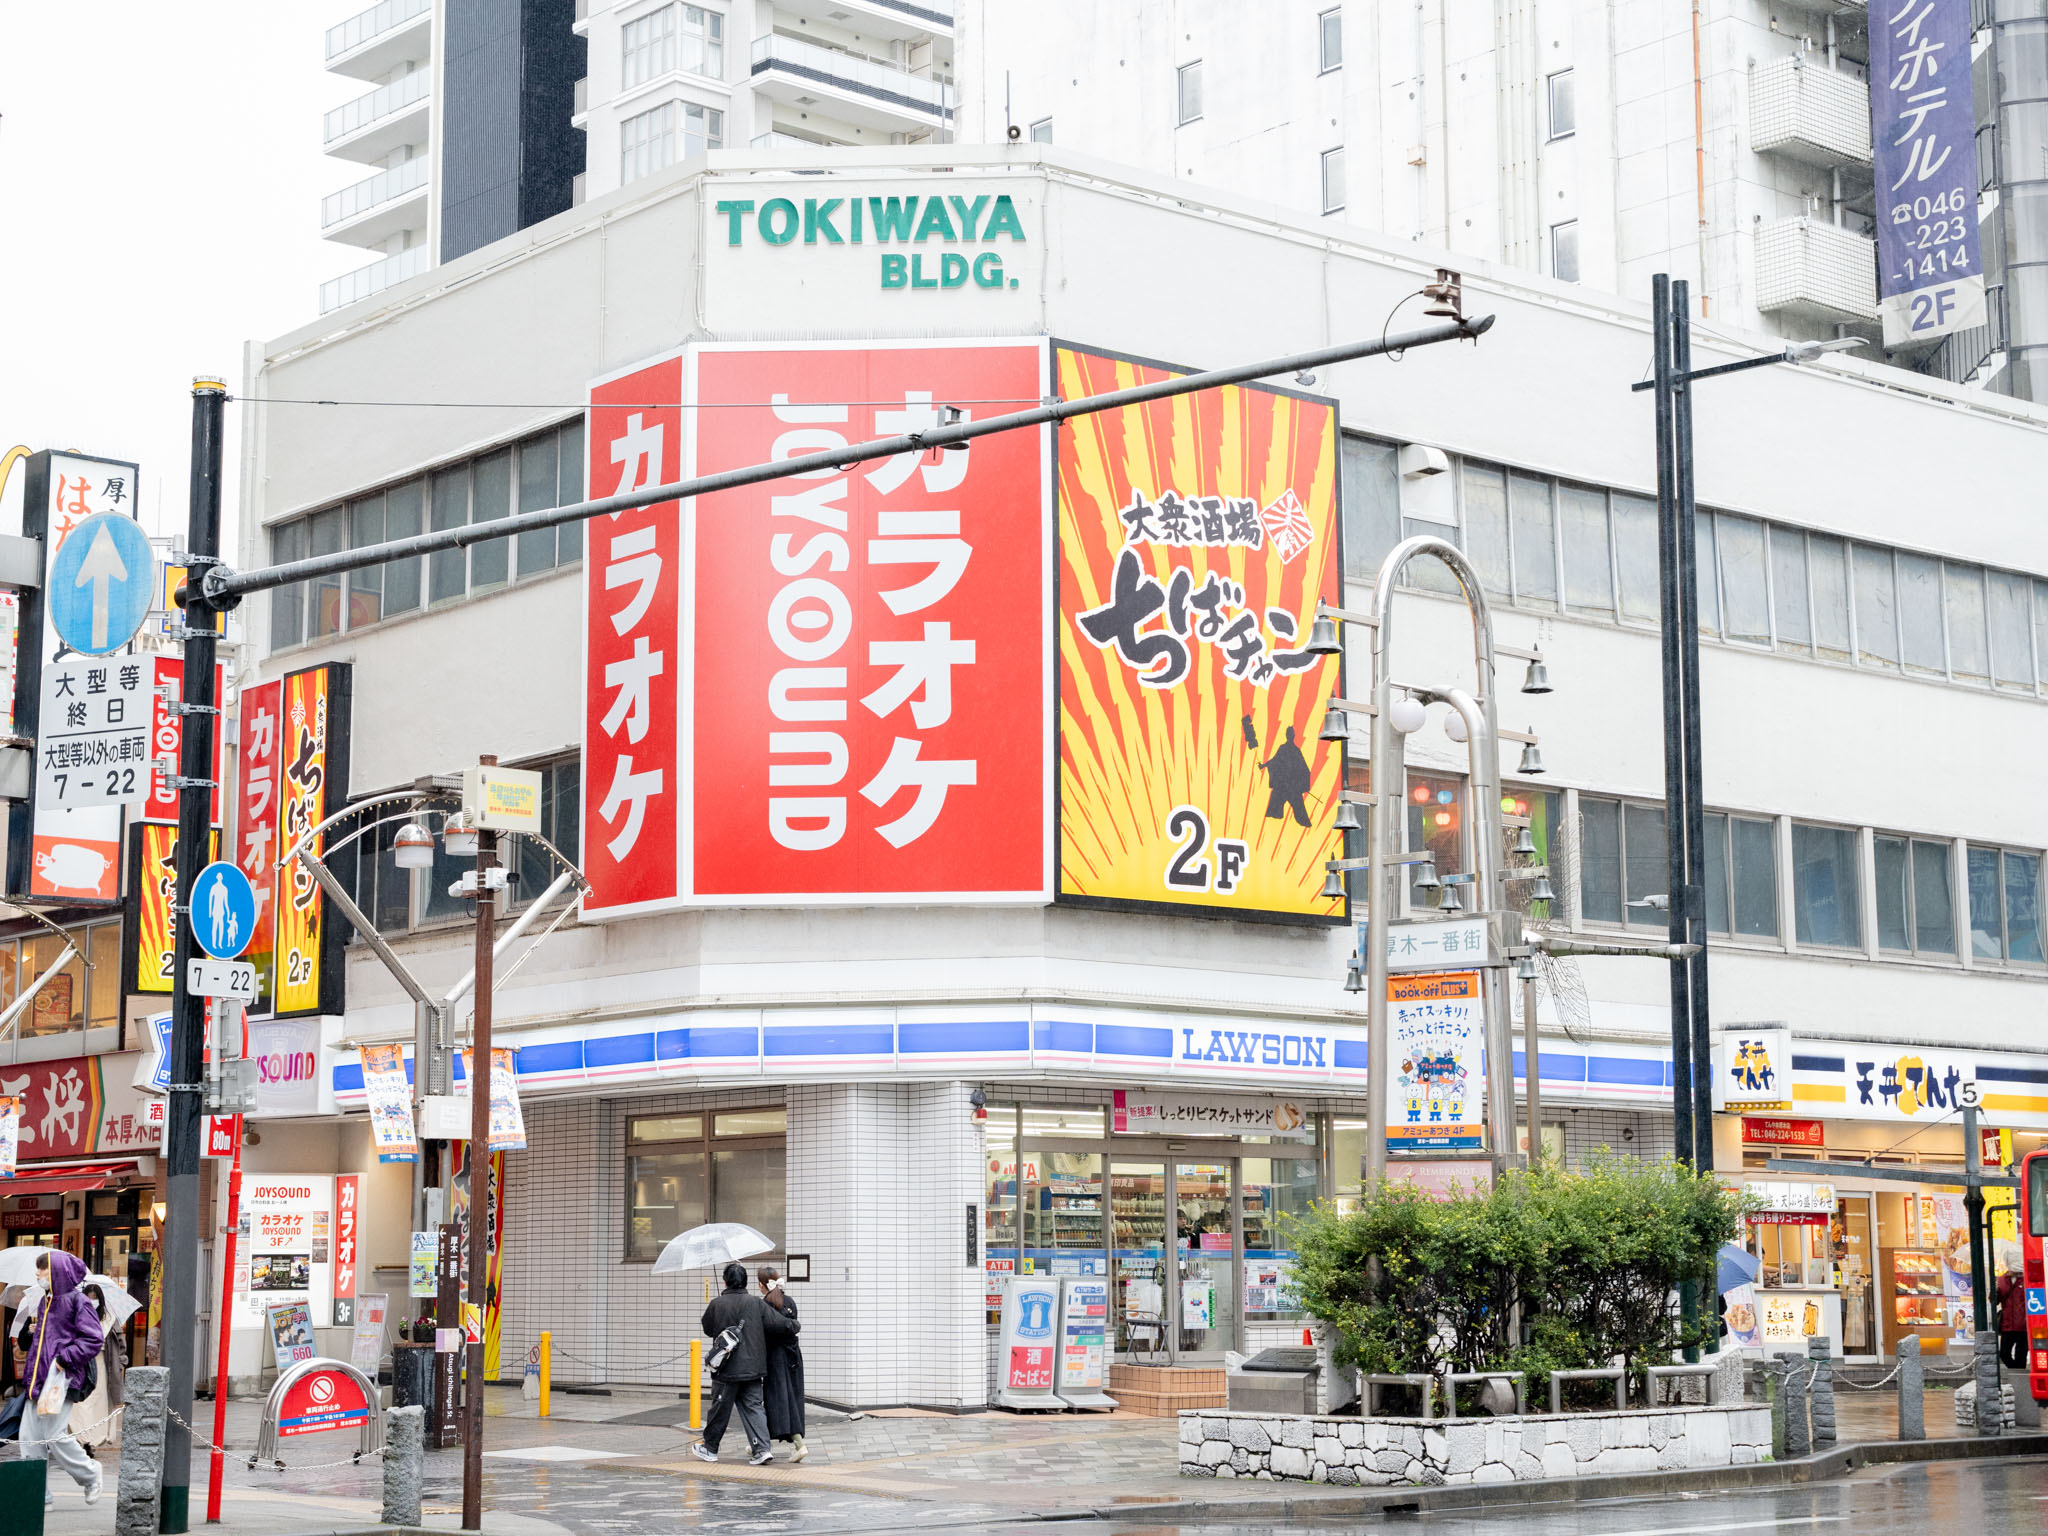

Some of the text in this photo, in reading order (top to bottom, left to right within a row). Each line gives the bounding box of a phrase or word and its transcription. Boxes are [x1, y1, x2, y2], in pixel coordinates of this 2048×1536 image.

[716, 195, 1026, 246] TOKIWAYA
[881, 252, 1019, 289] BLDG.
[1911, 288, 1956, 332] 2F
[1121, 489, 1262, 547] 大衆酒場
[767, 393, 852, 851] JOYSOUND
[858, 391, 977, 849] カラオケ
[1079, 549, 1321, 685] ちばチャン
[599, 412, 664, 863] カラオケ
[55, 664, 140, 698] 大型等
[67, 698, 125, 728] 終日
[44, 735, 146, 770] 大型等以外の車両
[243, 706, 275, 928] カラオケ
[1168, 810, 1246, 890] 2F
[289, 951, 311, 982] 2F
[1182, 1029, 1326, 1067] LAWSON
[1731, 1065, 1774, 1090] てんや
[1962, 1082, 1977, 1103] 5
[150, 1103, 164, 1121] 酒
[1160, 1105, 1274, 1125] しっとりビスケットサンド
[212, 1130, 231, 1151] 80m
[254, 1186, 311, 1198] JOYSOUND
[261, 1214, 304, 1226] カラオケ
[262, 1226, 302, 1236] JOYSOUND
[1751, 1212, 1813, 1223] お持ち帰りコーナー
[270, 1237, 283, 1247] 3F
[338, 1182, 355, 1292] カラオケ
[990, 1260, 1010, 1270] ATM
[338, 1302, 350, 1323] 3F
[292, 1345, 312, 1361] 660
[1027, 1348, 1042, 1365] 酒
[1012, 1369, 1049, 1386] たばこ
